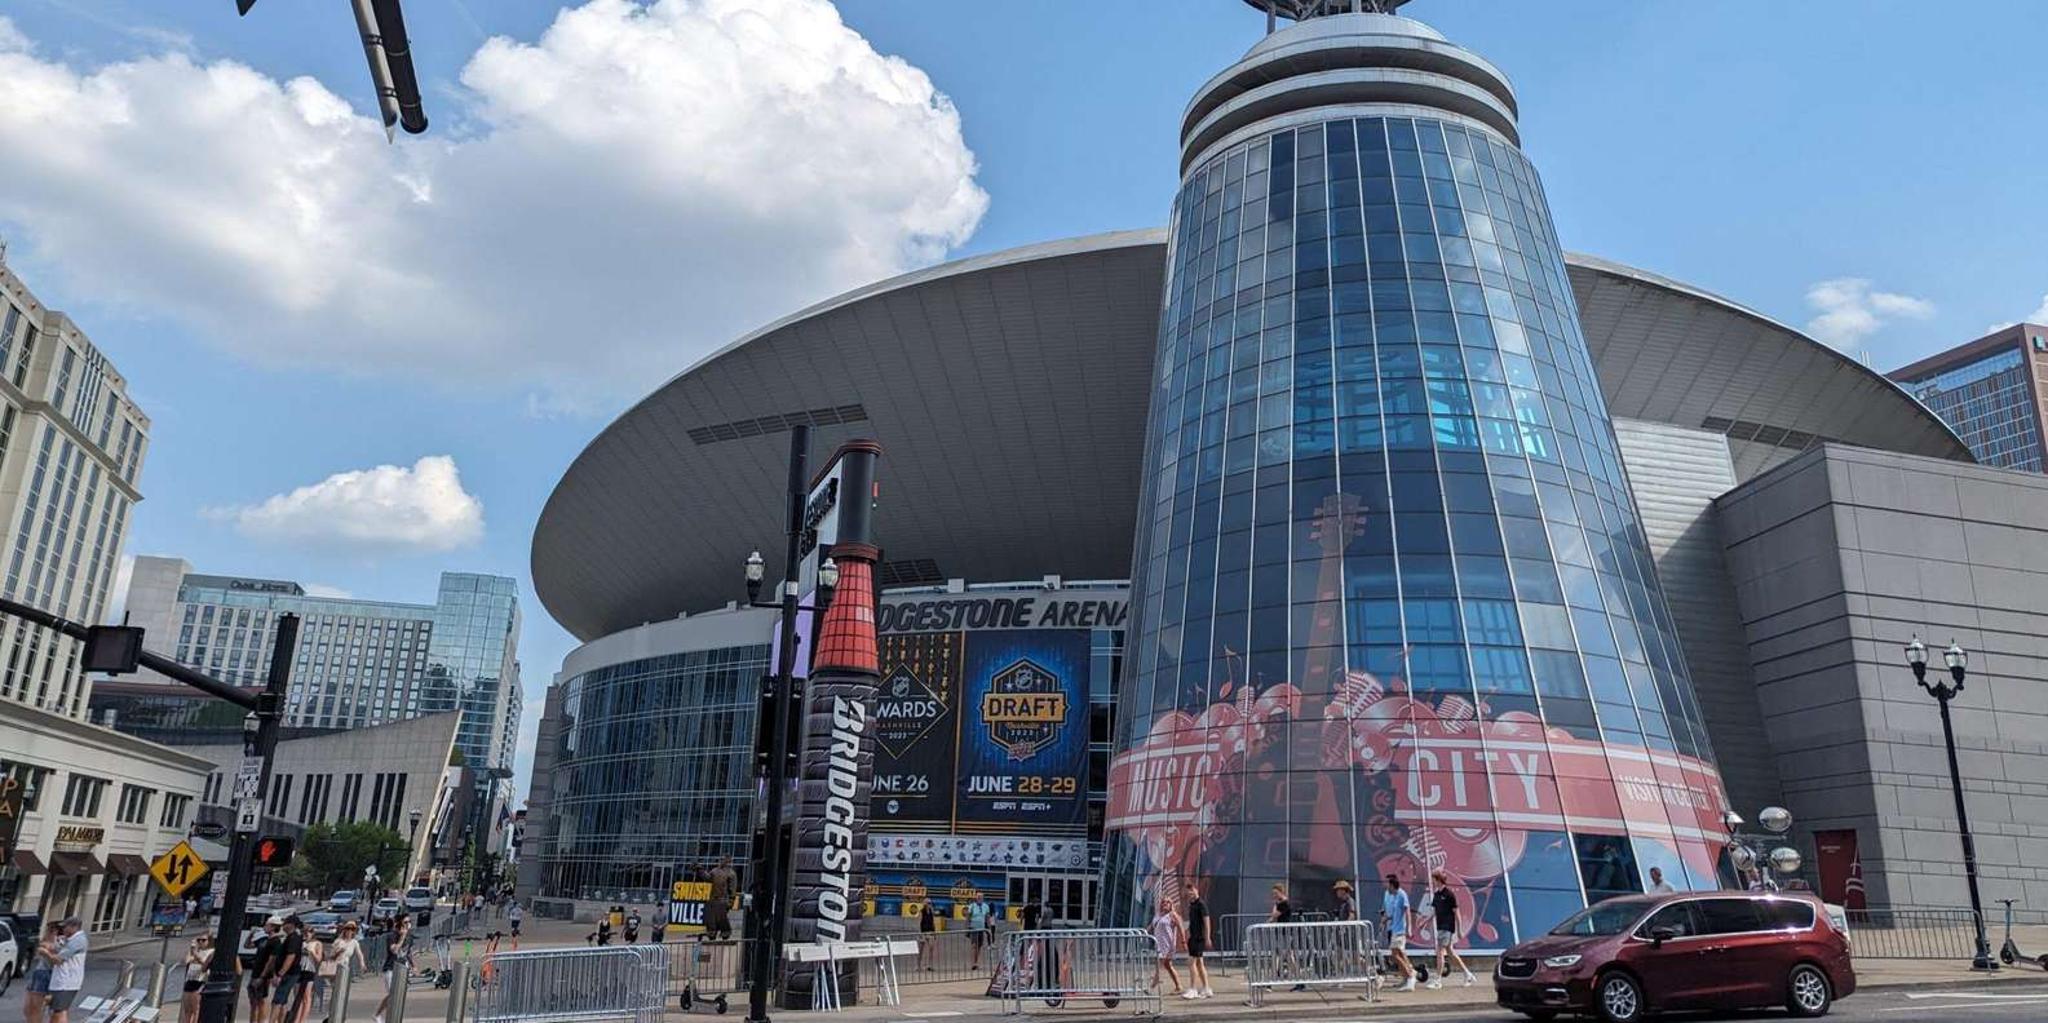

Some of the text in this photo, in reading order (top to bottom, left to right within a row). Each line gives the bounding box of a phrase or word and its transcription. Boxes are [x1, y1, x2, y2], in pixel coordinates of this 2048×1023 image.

[988, 698, 1060, 717] DRAFT
[907, 774, 929, 793] 26
[968, 775, 1076, 794] JUNE 28-29
[1128, 749, 1541, 813] MUSIC CITY
[816, 694, 866, 950] BRIDGESTON
[671, 902, 705, 925] VILLE
